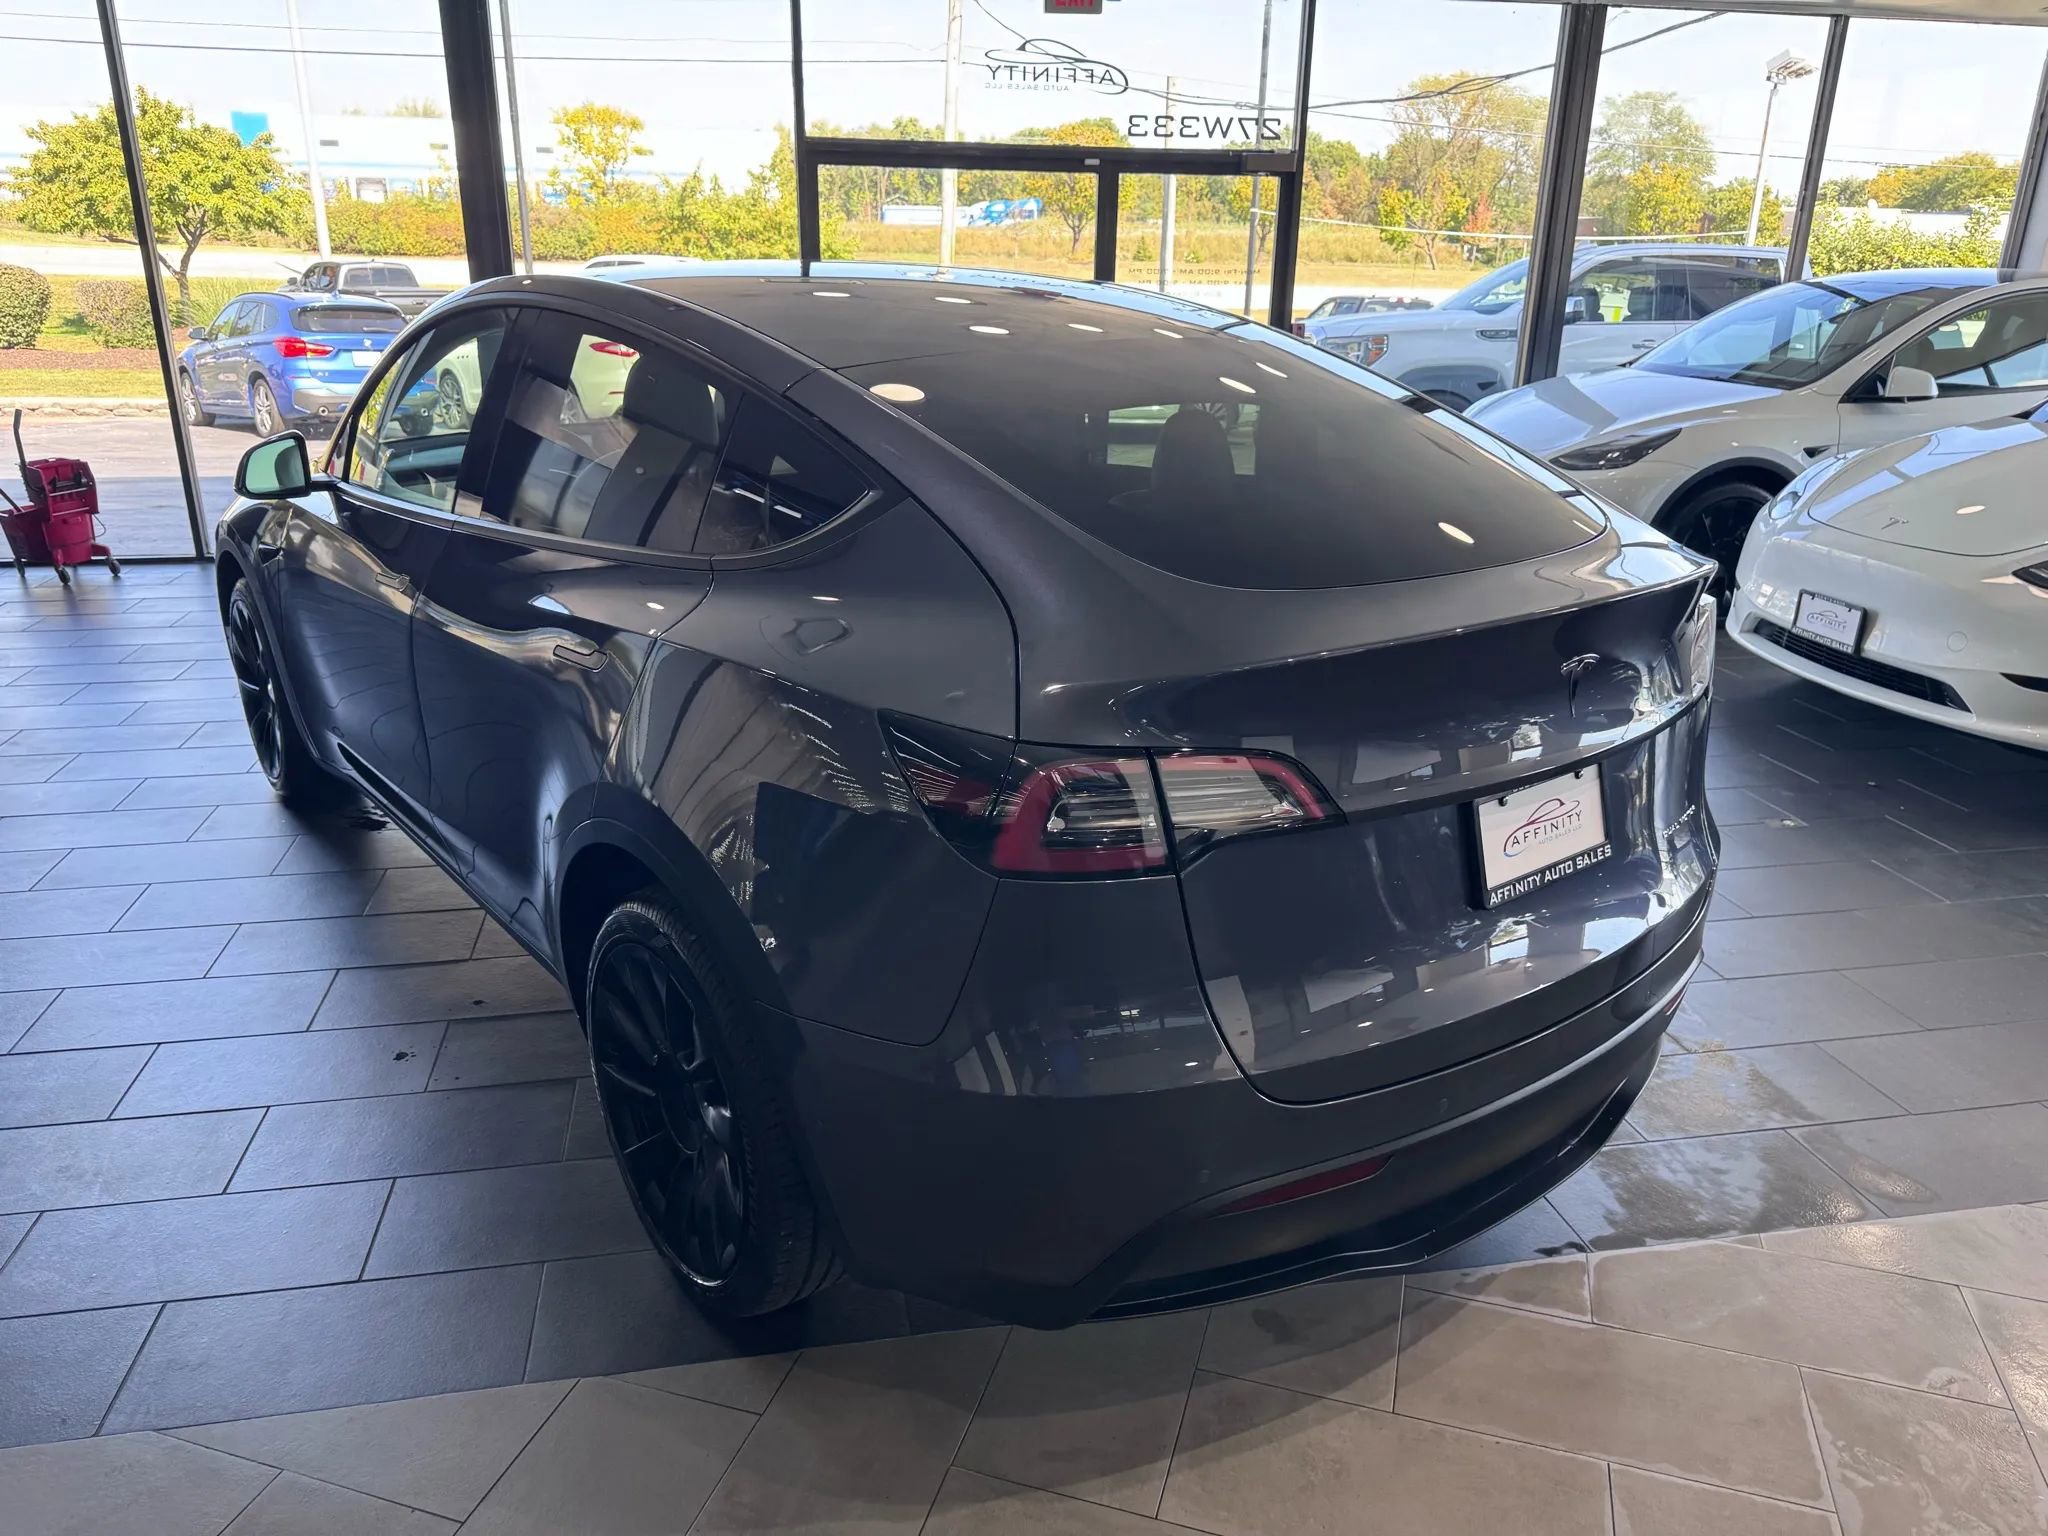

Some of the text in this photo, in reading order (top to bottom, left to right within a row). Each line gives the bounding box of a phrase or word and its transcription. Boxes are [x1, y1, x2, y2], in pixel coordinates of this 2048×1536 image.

[1511, 809, 1583, 848] AFFINITY
[1489, 844, 1612, 907] AFFINITY AUTO SALES
